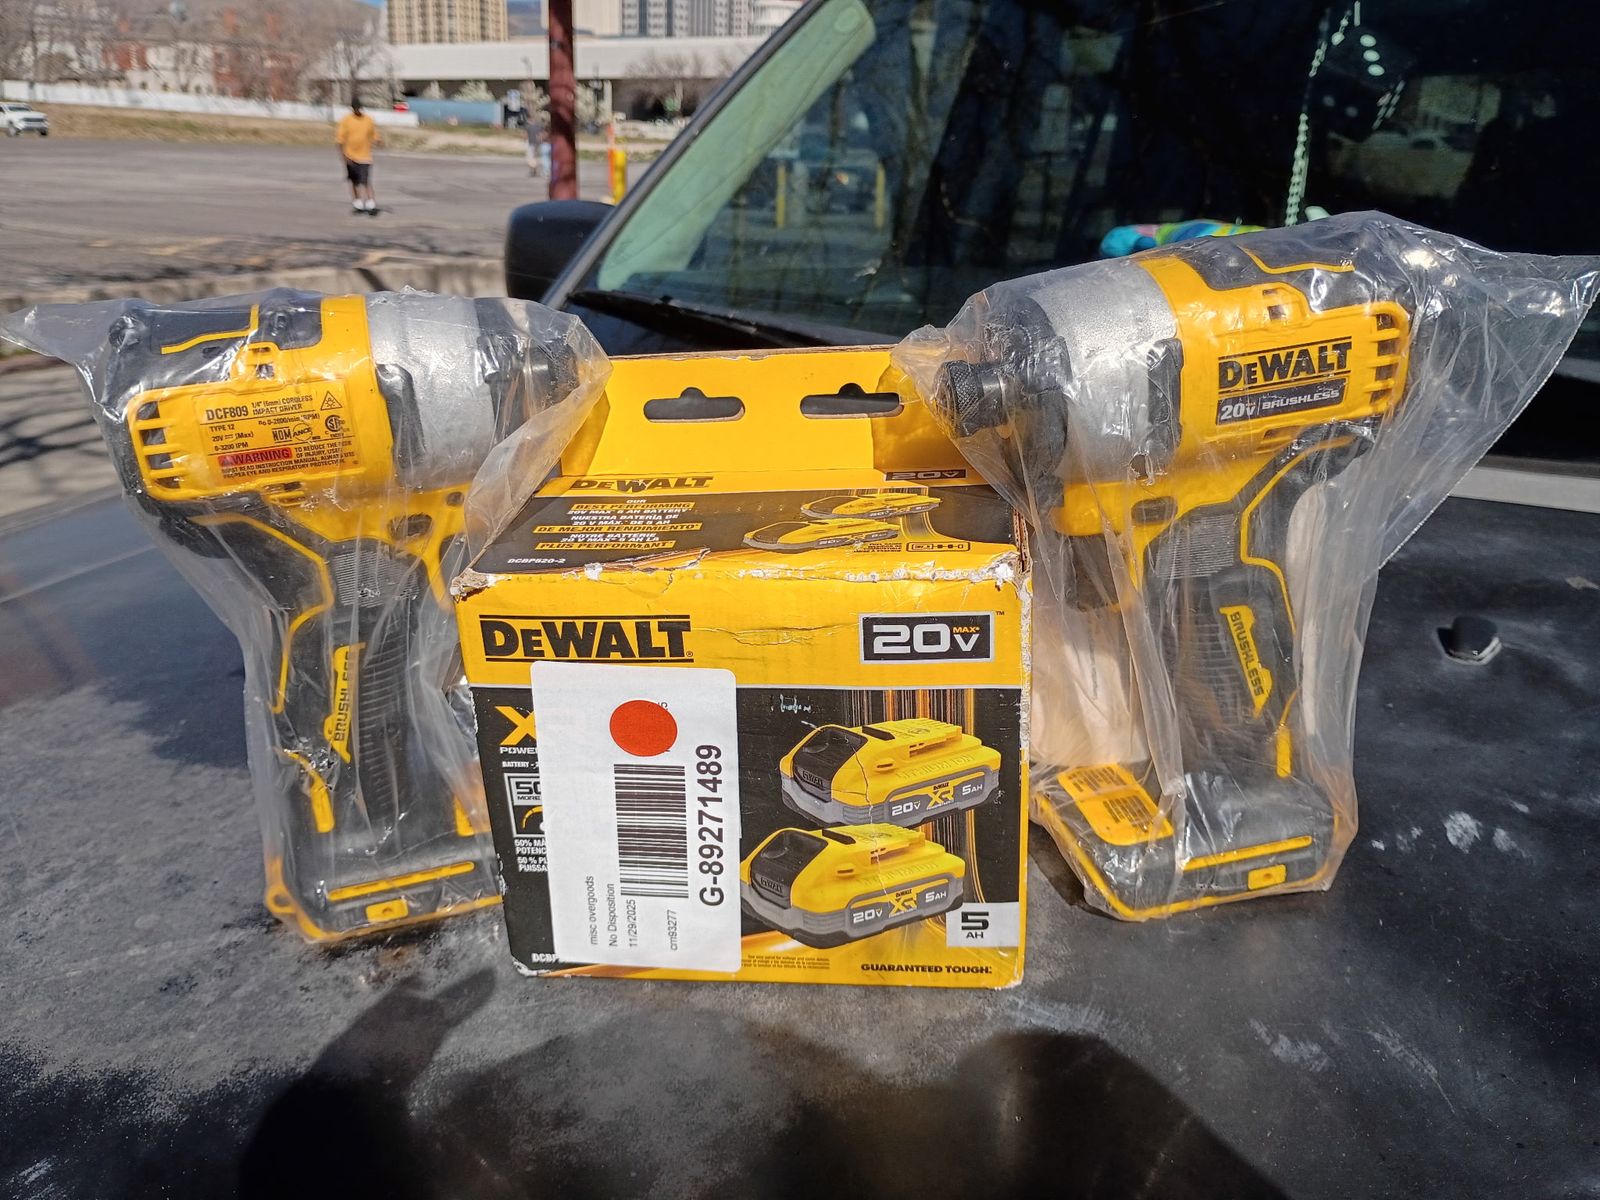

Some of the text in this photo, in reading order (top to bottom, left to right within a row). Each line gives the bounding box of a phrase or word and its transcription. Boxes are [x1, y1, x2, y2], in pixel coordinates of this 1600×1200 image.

[1218, 341, 1352, 389] DEWALT
[1262, 389, 1340, 410] BRUSHLESS
[206, 405, 249, 421] DCF809
[209, 423, 235, 432] TYPE 12
[272, 428, 292, 441] NOM
[232, 449, 290, 464] WARNING
[571, 477, 714, 492] DEWALT
[873, 623, 980, 654] 20V
[1230, 611, 1265, 697] BRUSHLESS
[892, 801, 921, 817] 20V
[696, 744, 725, 907] G-89271489
[585, 875, 598, 945] misc overgoods
[606, 883, 618, 947] No Disposition
[853, 907, 883, 924] 20V
[626, 899, 638, 948] 11/29/2025
[667, 909, 678, 951] cm93277
[960, 911, 990, 931] 5
[966, 931, 984, 939] AH
[860, 964, 943, 973] GUARANTEED
